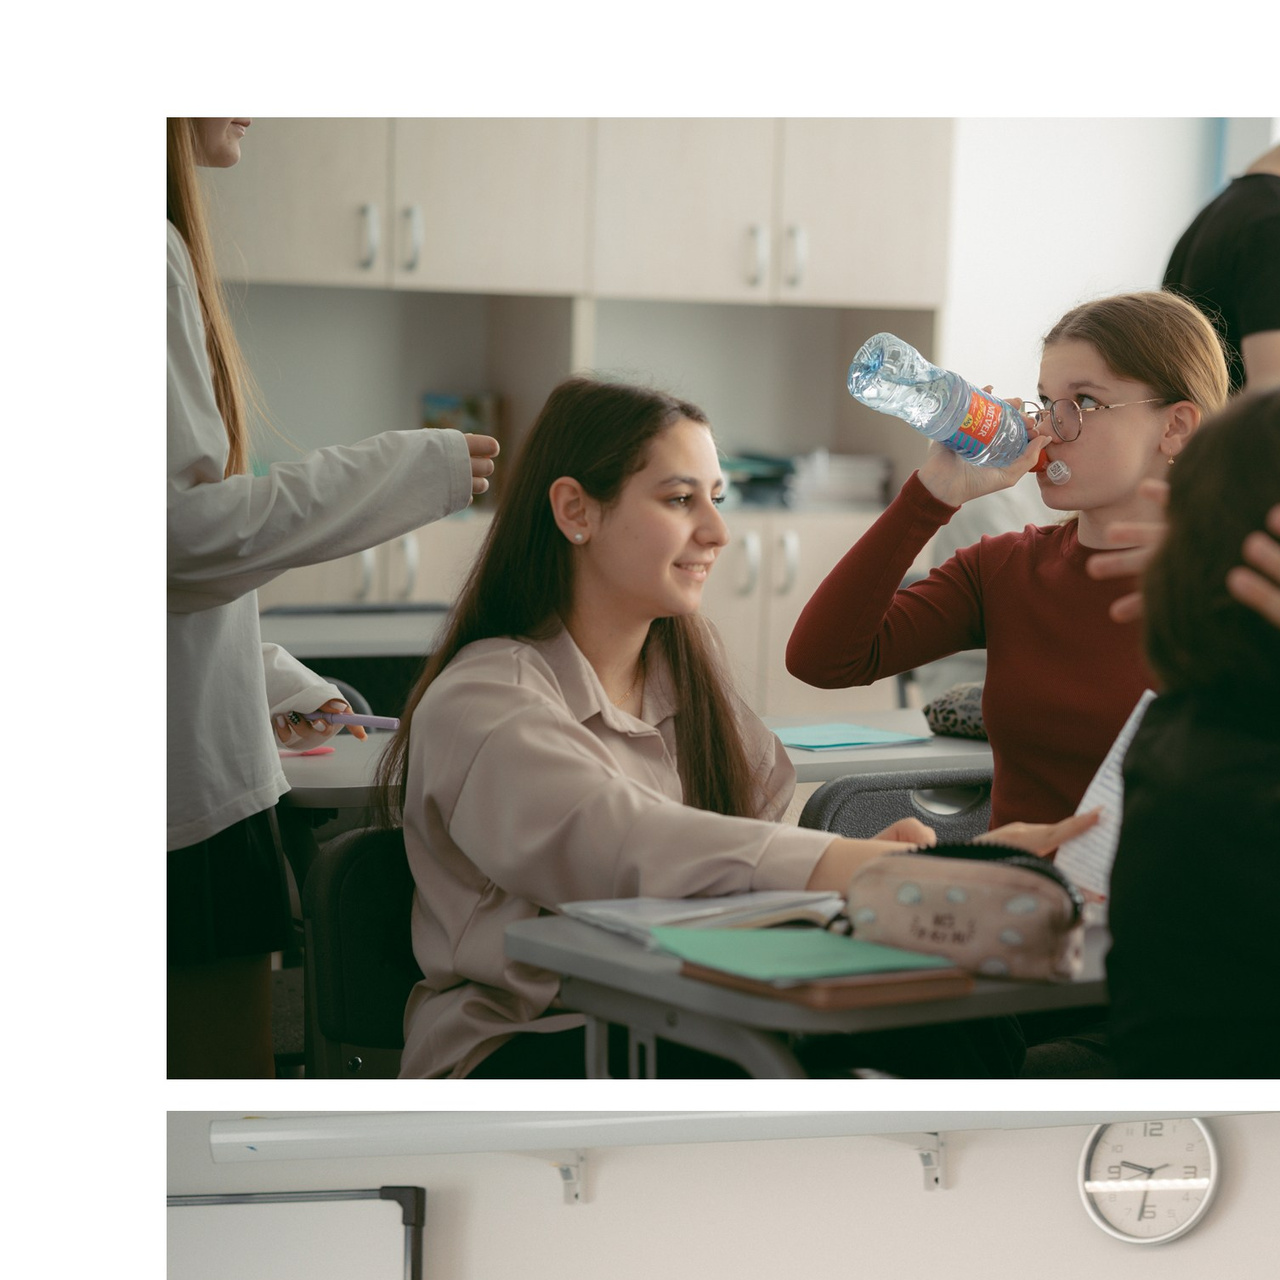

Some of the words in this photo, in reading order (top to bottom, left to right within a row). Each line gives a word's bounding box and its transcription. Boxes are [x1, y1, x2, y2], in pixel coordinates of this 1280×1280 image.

[977, 403, 995, 437] MEVER
[1143, 1121, 1164, 1137] 12
[1111, 1144, 1123, 1153] 10
[1185, 1143, 1195, 1152] 2
[1107, 1165, 1122, 1180] 9
[1183, 1165, 1197, 1179] 3
[1182, 1192, 1190, 1202] 4
[1142, 1204, 1157, 1219] 6
